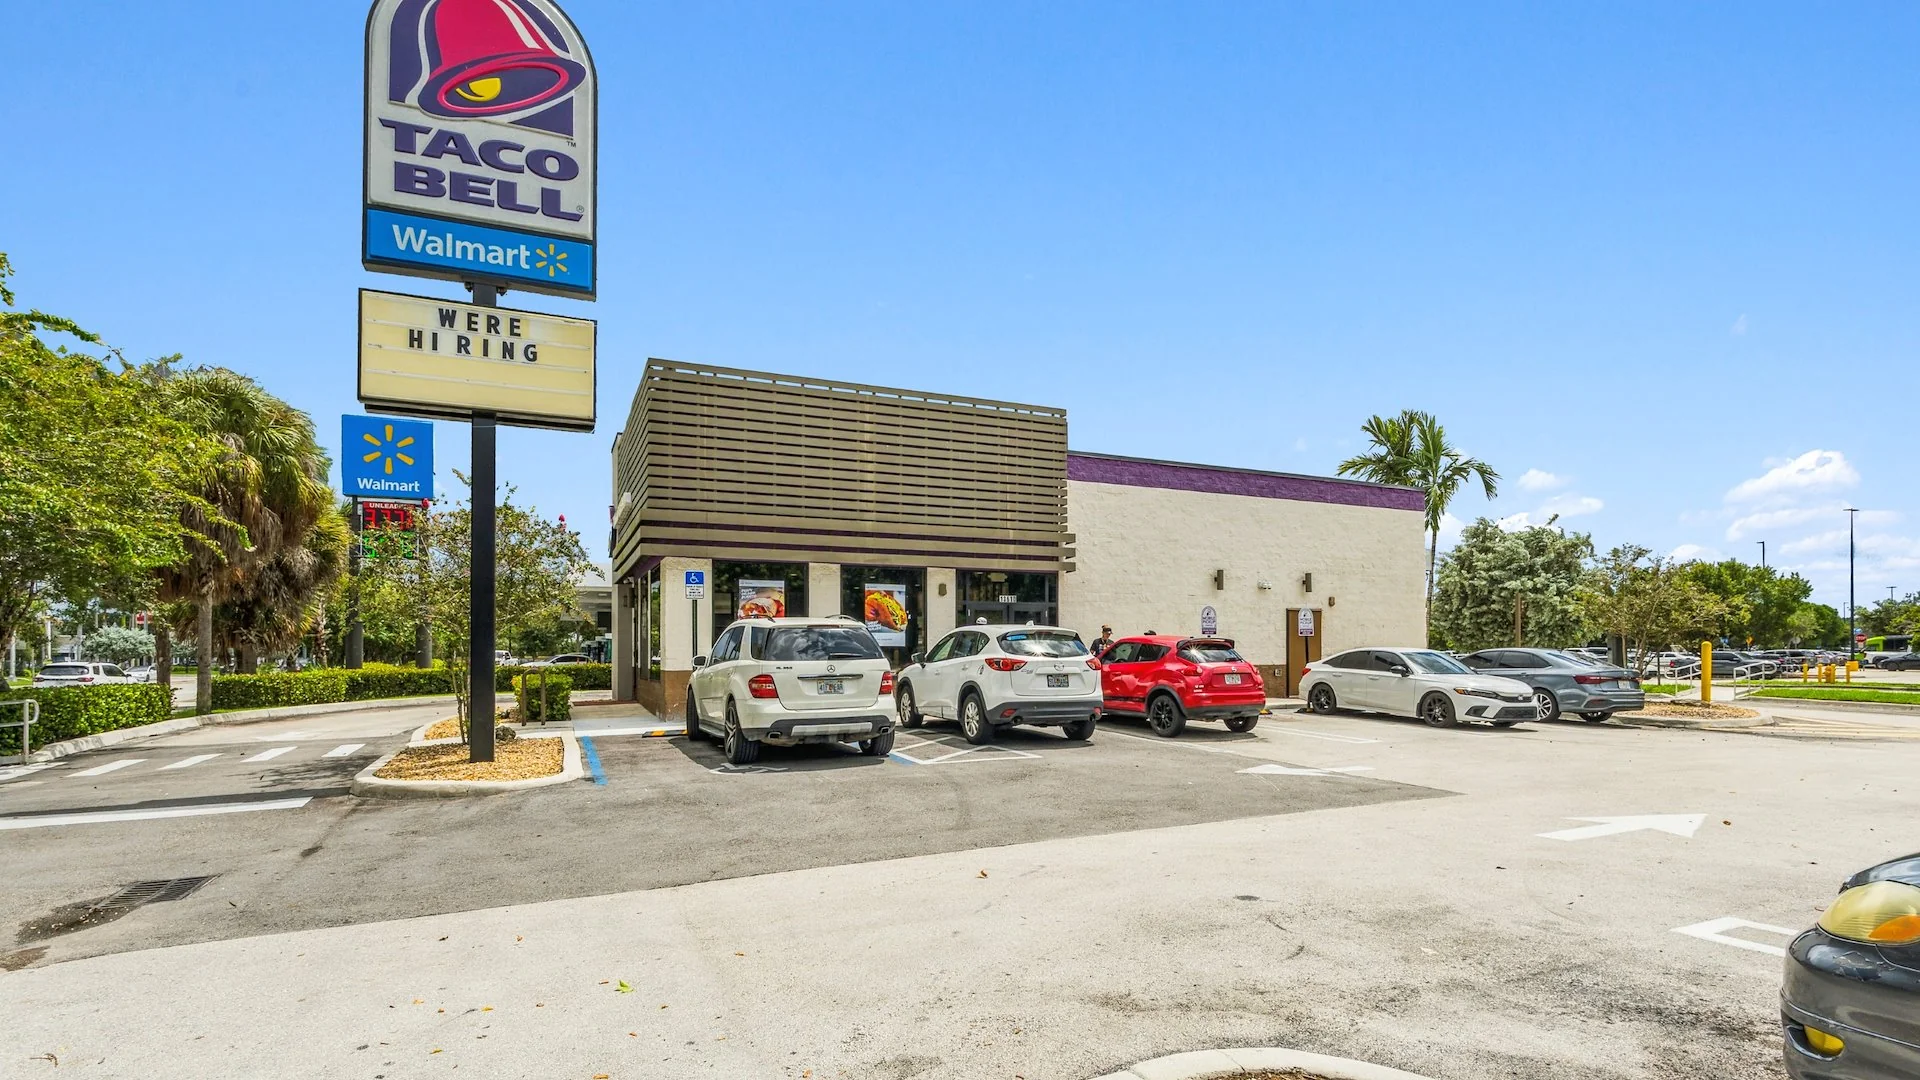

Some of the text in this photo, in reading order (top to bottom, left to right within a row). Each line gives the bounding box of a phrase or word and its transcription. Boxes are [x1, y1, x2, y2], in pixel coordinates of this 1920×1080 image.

[378, 117, 579, 181] TACO
[394, 161, 584, 222] BELL
[392, 224, 530, 269] Walmart
[438, 308, 521, 337] WERE
[409, 329, 538, 362] HIRING
[357, 477, 420, 492] Walmart
[369, 502, 411, 510] UNLEAD
